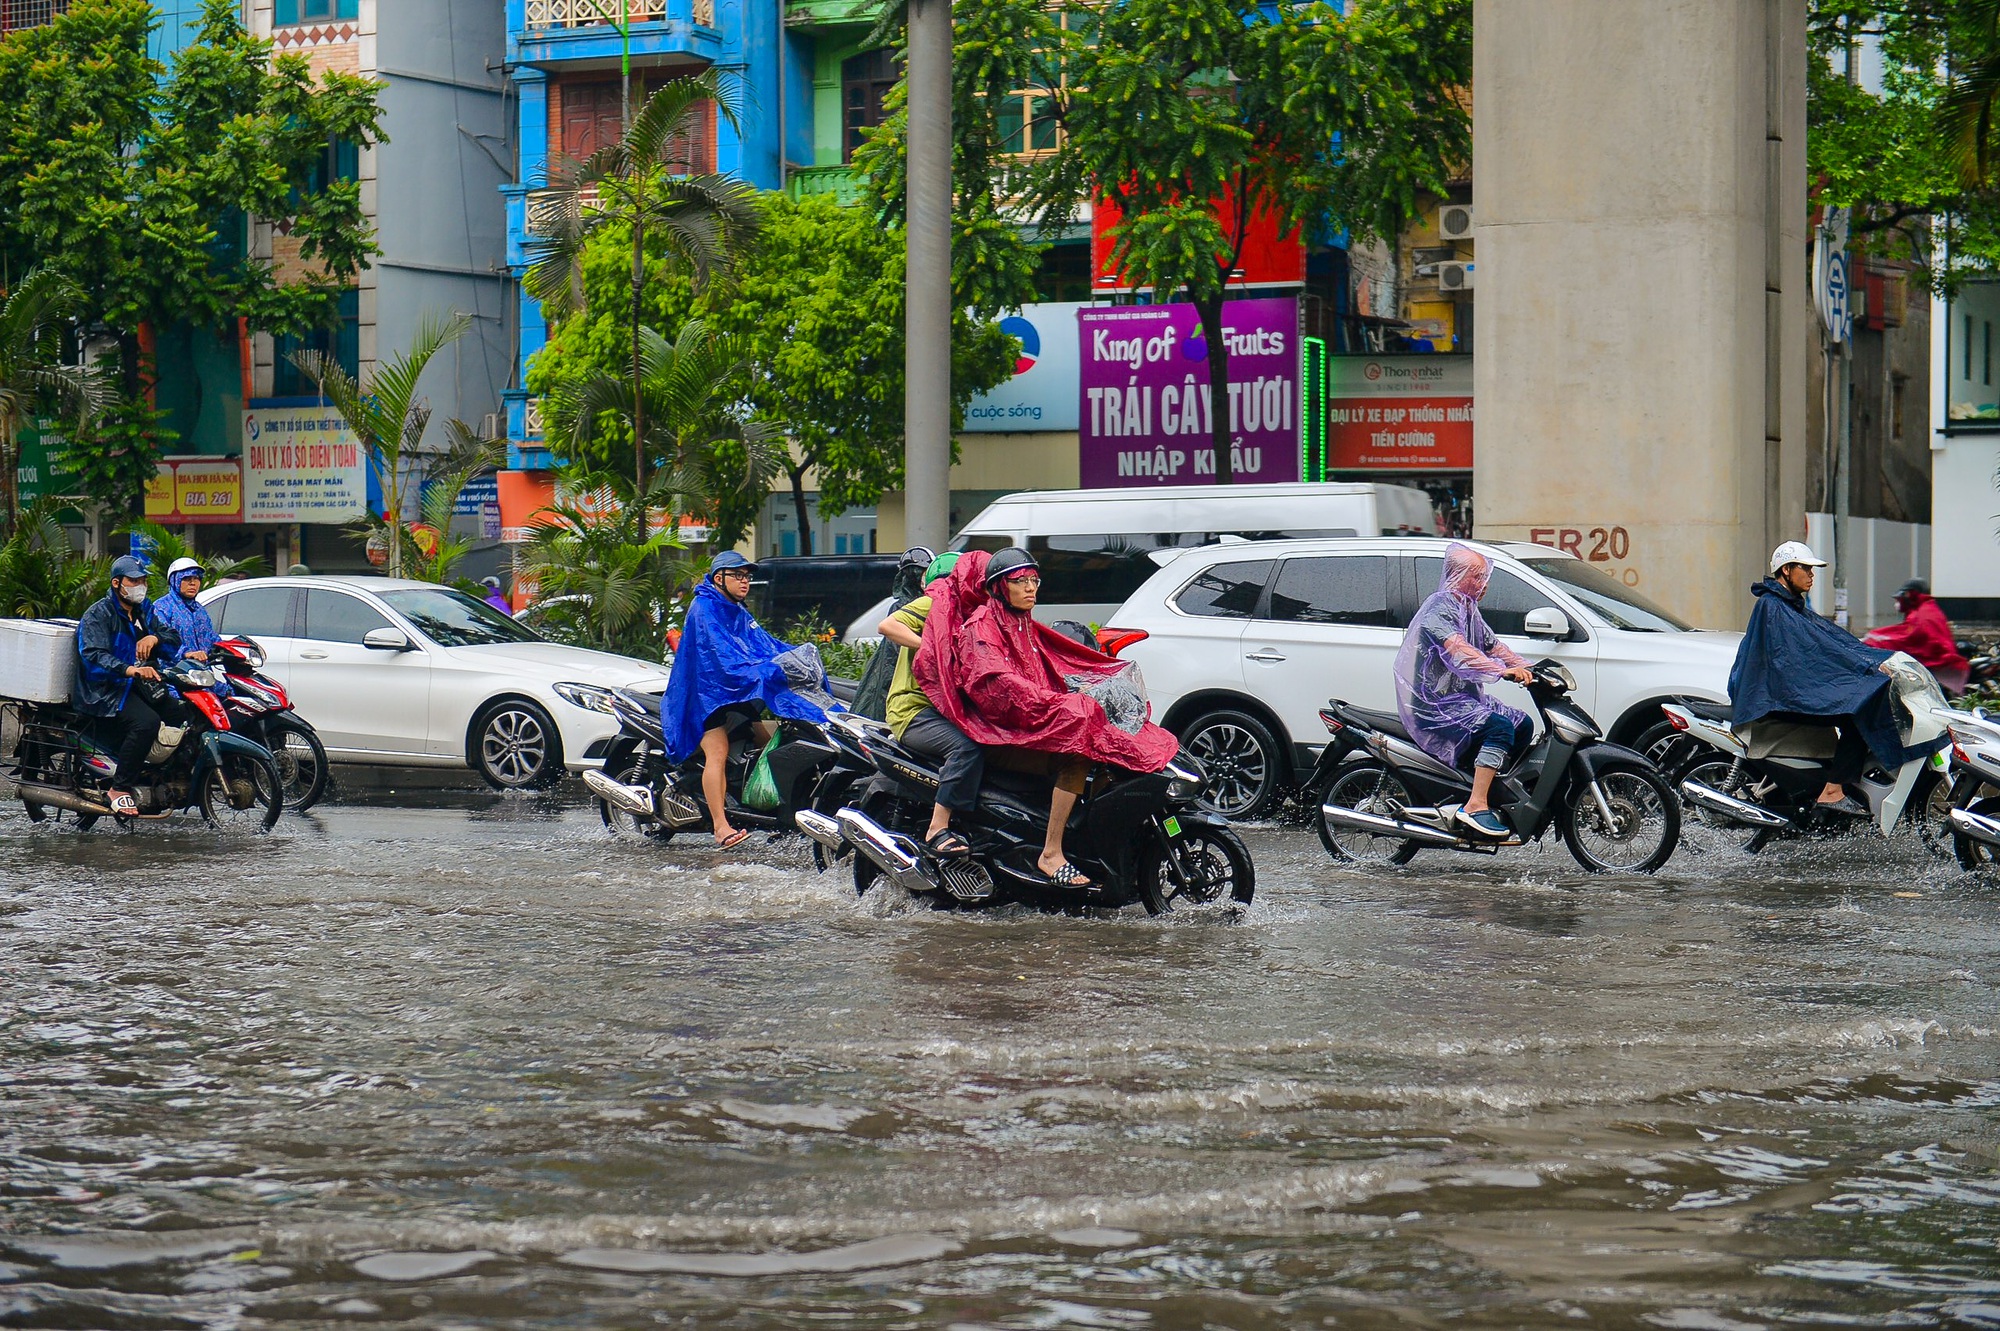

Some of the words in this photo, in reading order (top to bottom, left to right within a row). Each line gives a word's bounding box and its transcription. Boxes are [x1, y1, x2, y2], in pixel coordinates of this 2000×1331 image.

[1093, 328, 1143, 370] King
[1146, 325, 1176, 360] of
[971, 404, 1005, 421] cuộc
[1008, 402, 1042, 421] sống
[1087, 374, 1151, 437] TRÁI
[1161, 373, 1213, 436] CÂY
[1227, 375, 1292, 433] TƯƠI
[1330, 408, 1350, 426] ĐẠI
[1352, 405, 1364, 422] LÝ
[1367, 408, 1381, 423] XE
[1384, 408, 1406, 426] ĐẠP
[1409, 403, 1444, 423] THỐNG
[1370, 428, 1396, 446] TIẾN
[1397, 429, 1435, 447] CƯỜNG
[250, 445, 265, 475] ĐẠI
[268, 441, 277, 470] LÝ
[280, 436, 292, 469] XỔ
[295, 437, 307, 469] SỐ
[309, 440, 331, 474] ĐIỆN
[333, 439, 357, 468] TOÁN
[1118, 445, 1185, 482] NHẬP
[264, 478, 285, 487] CHÚC
[287, 479, 303, 488] BẠN
[305, 478, 322, 486] MAY
[185, 492, 206, 506] BIA
[211, 491, 232, 505] 261
